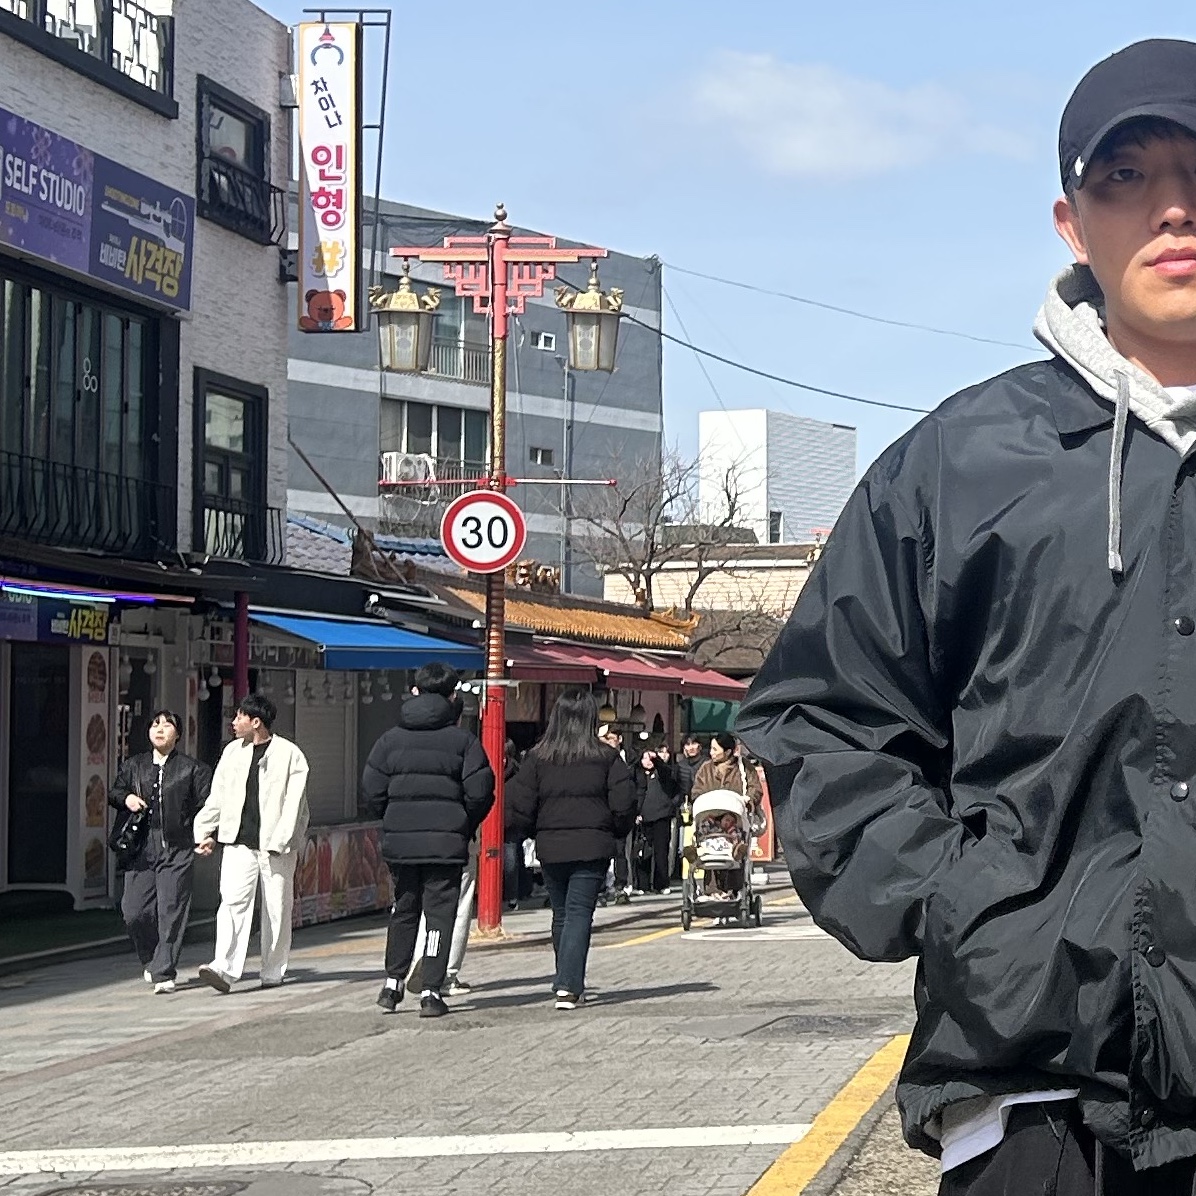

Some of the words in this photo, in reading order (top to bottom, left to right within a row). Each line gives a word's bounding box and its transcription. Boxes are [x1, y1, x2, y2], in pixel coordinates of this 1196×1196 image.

[310, 76, 343, 129] 차이나
[5, 153, 38, 195] SELF
[39, 168, 86, 217] STUDIO
[311, 145, 343, 226] 인형
[99, 242, 127, 272] 비비탄
[124, 235, 182, 298] 사격장
[461, 516, 508, 549] 30
[68, 608, 108, 641] 사격장
